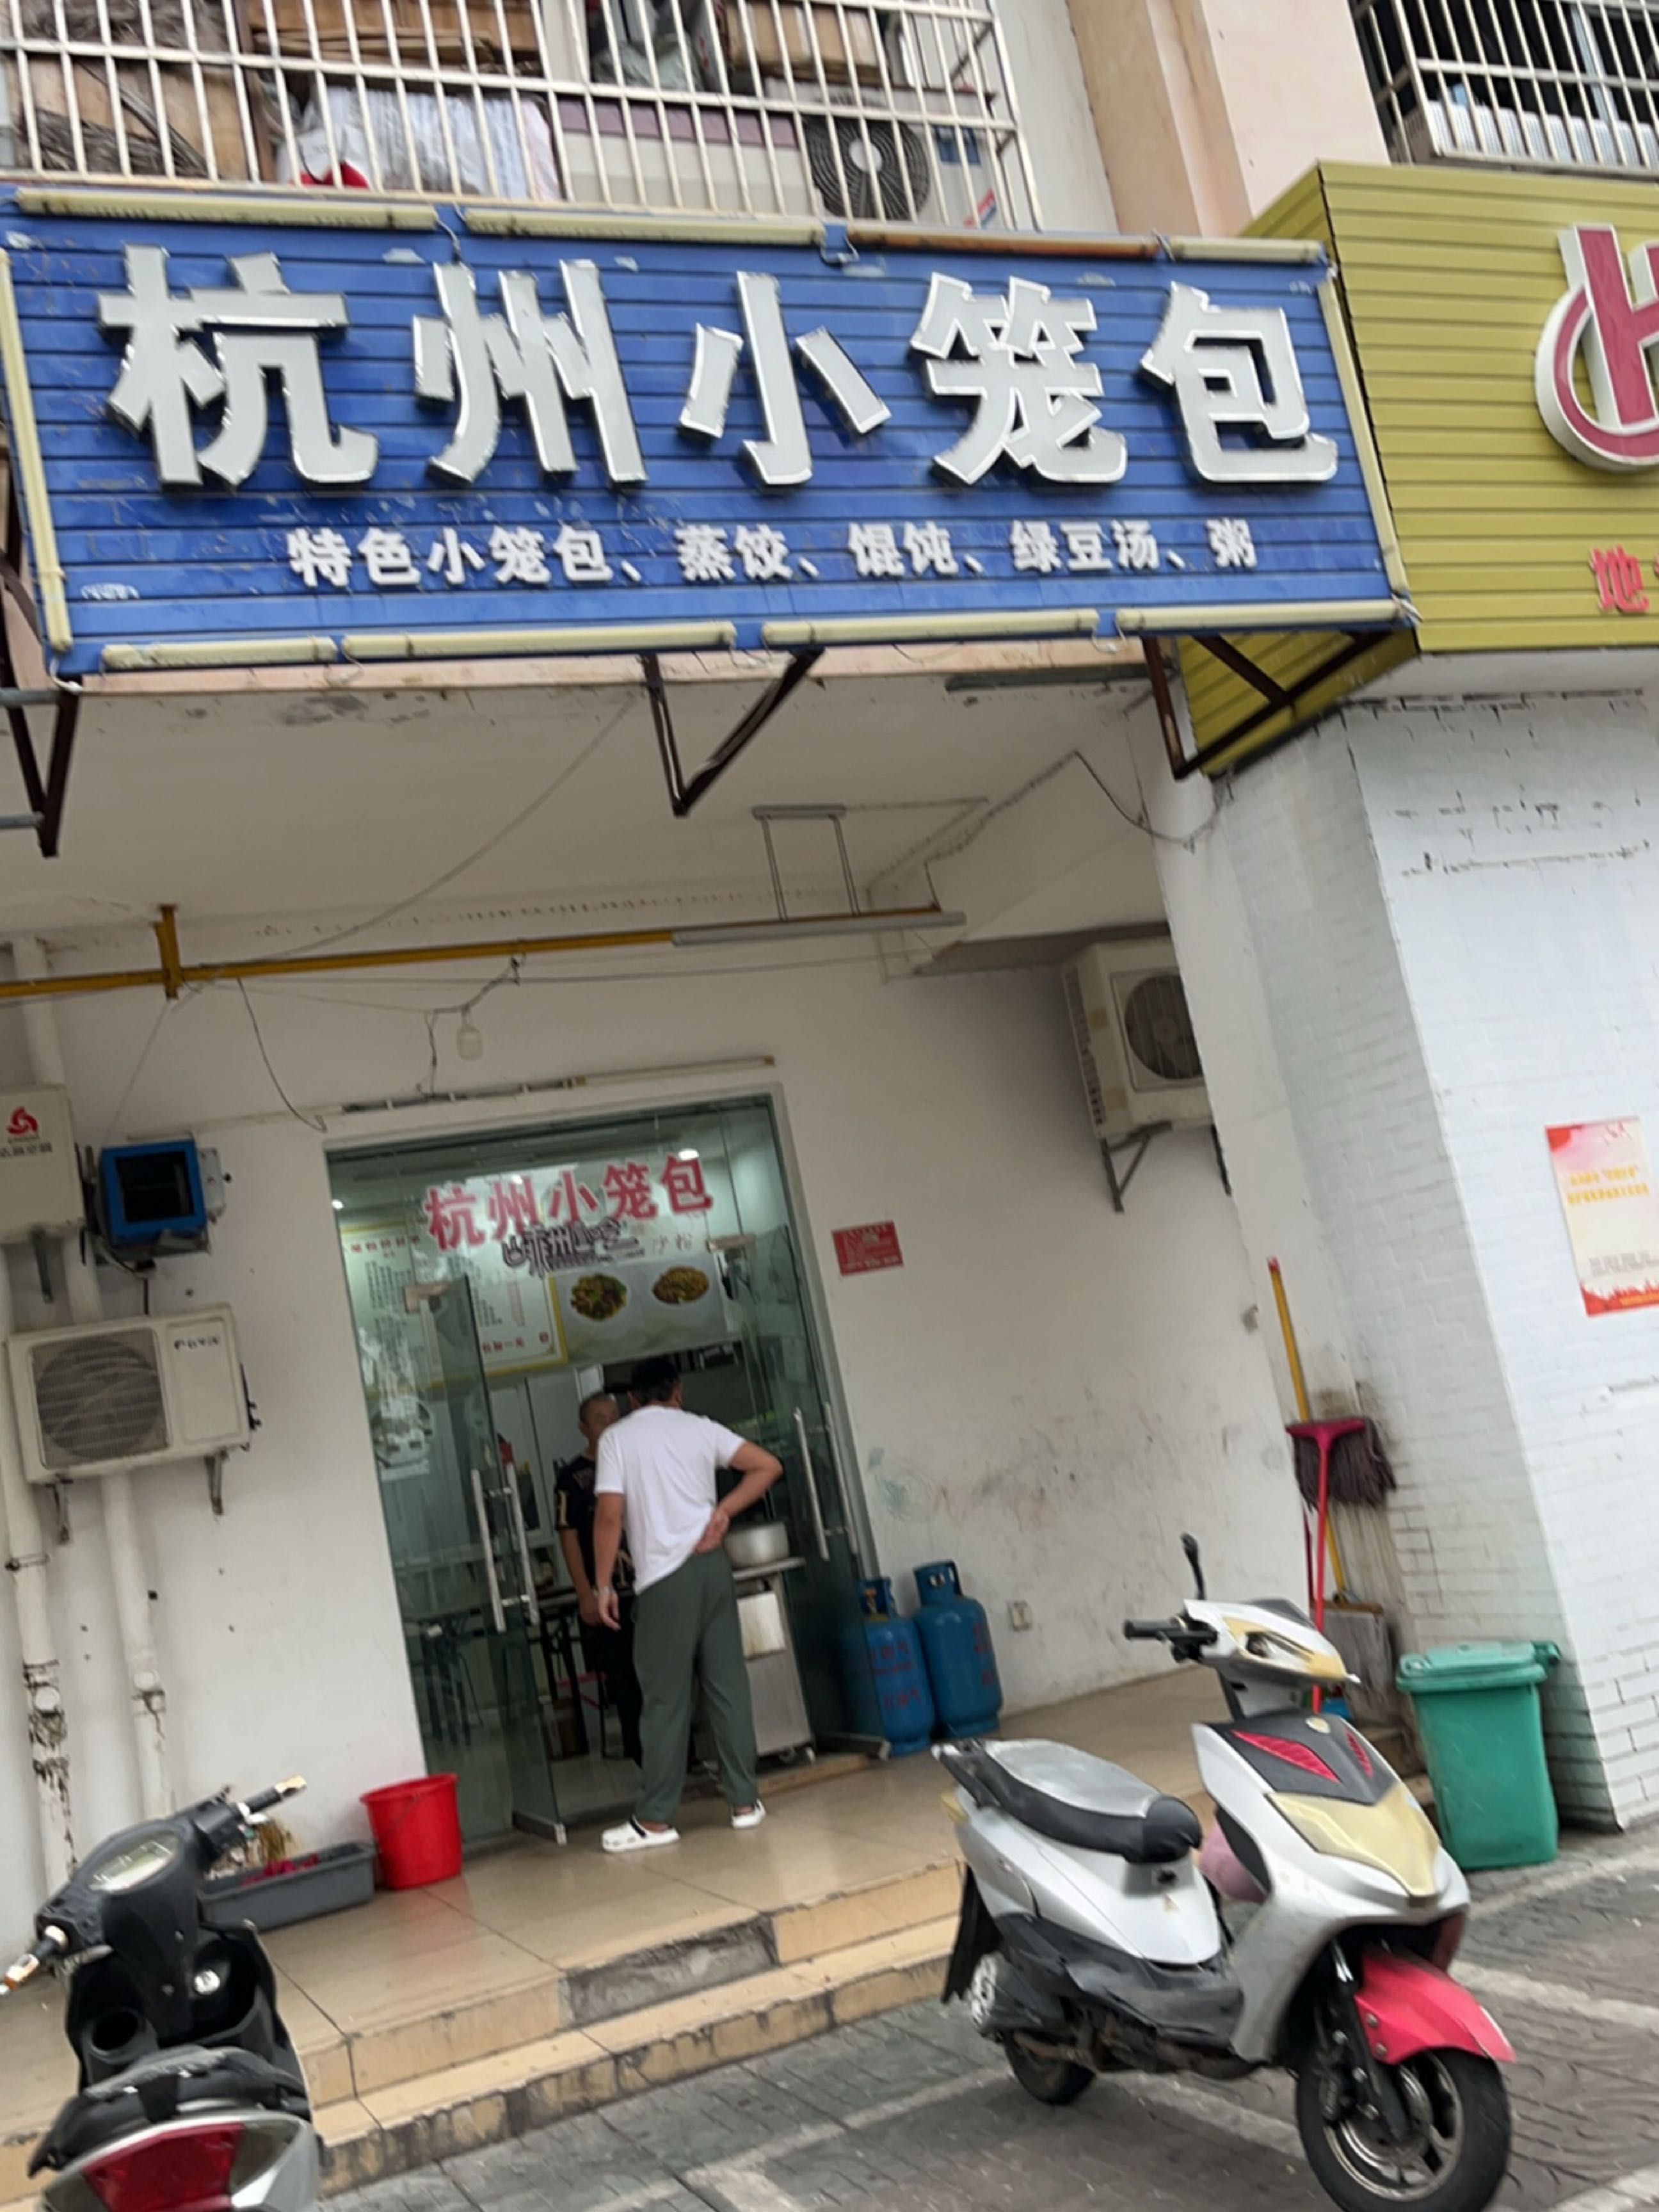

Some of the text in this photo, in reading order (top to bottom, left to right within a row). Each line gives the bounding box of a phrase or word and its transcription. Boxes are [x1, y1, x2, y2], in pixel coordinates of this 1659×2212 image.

[98, 242, 1338, 491] 杭州小笼包
[1590, 544, 1659, 614] 地
[425, 1155, 712, 1250] 杭州小笼包
